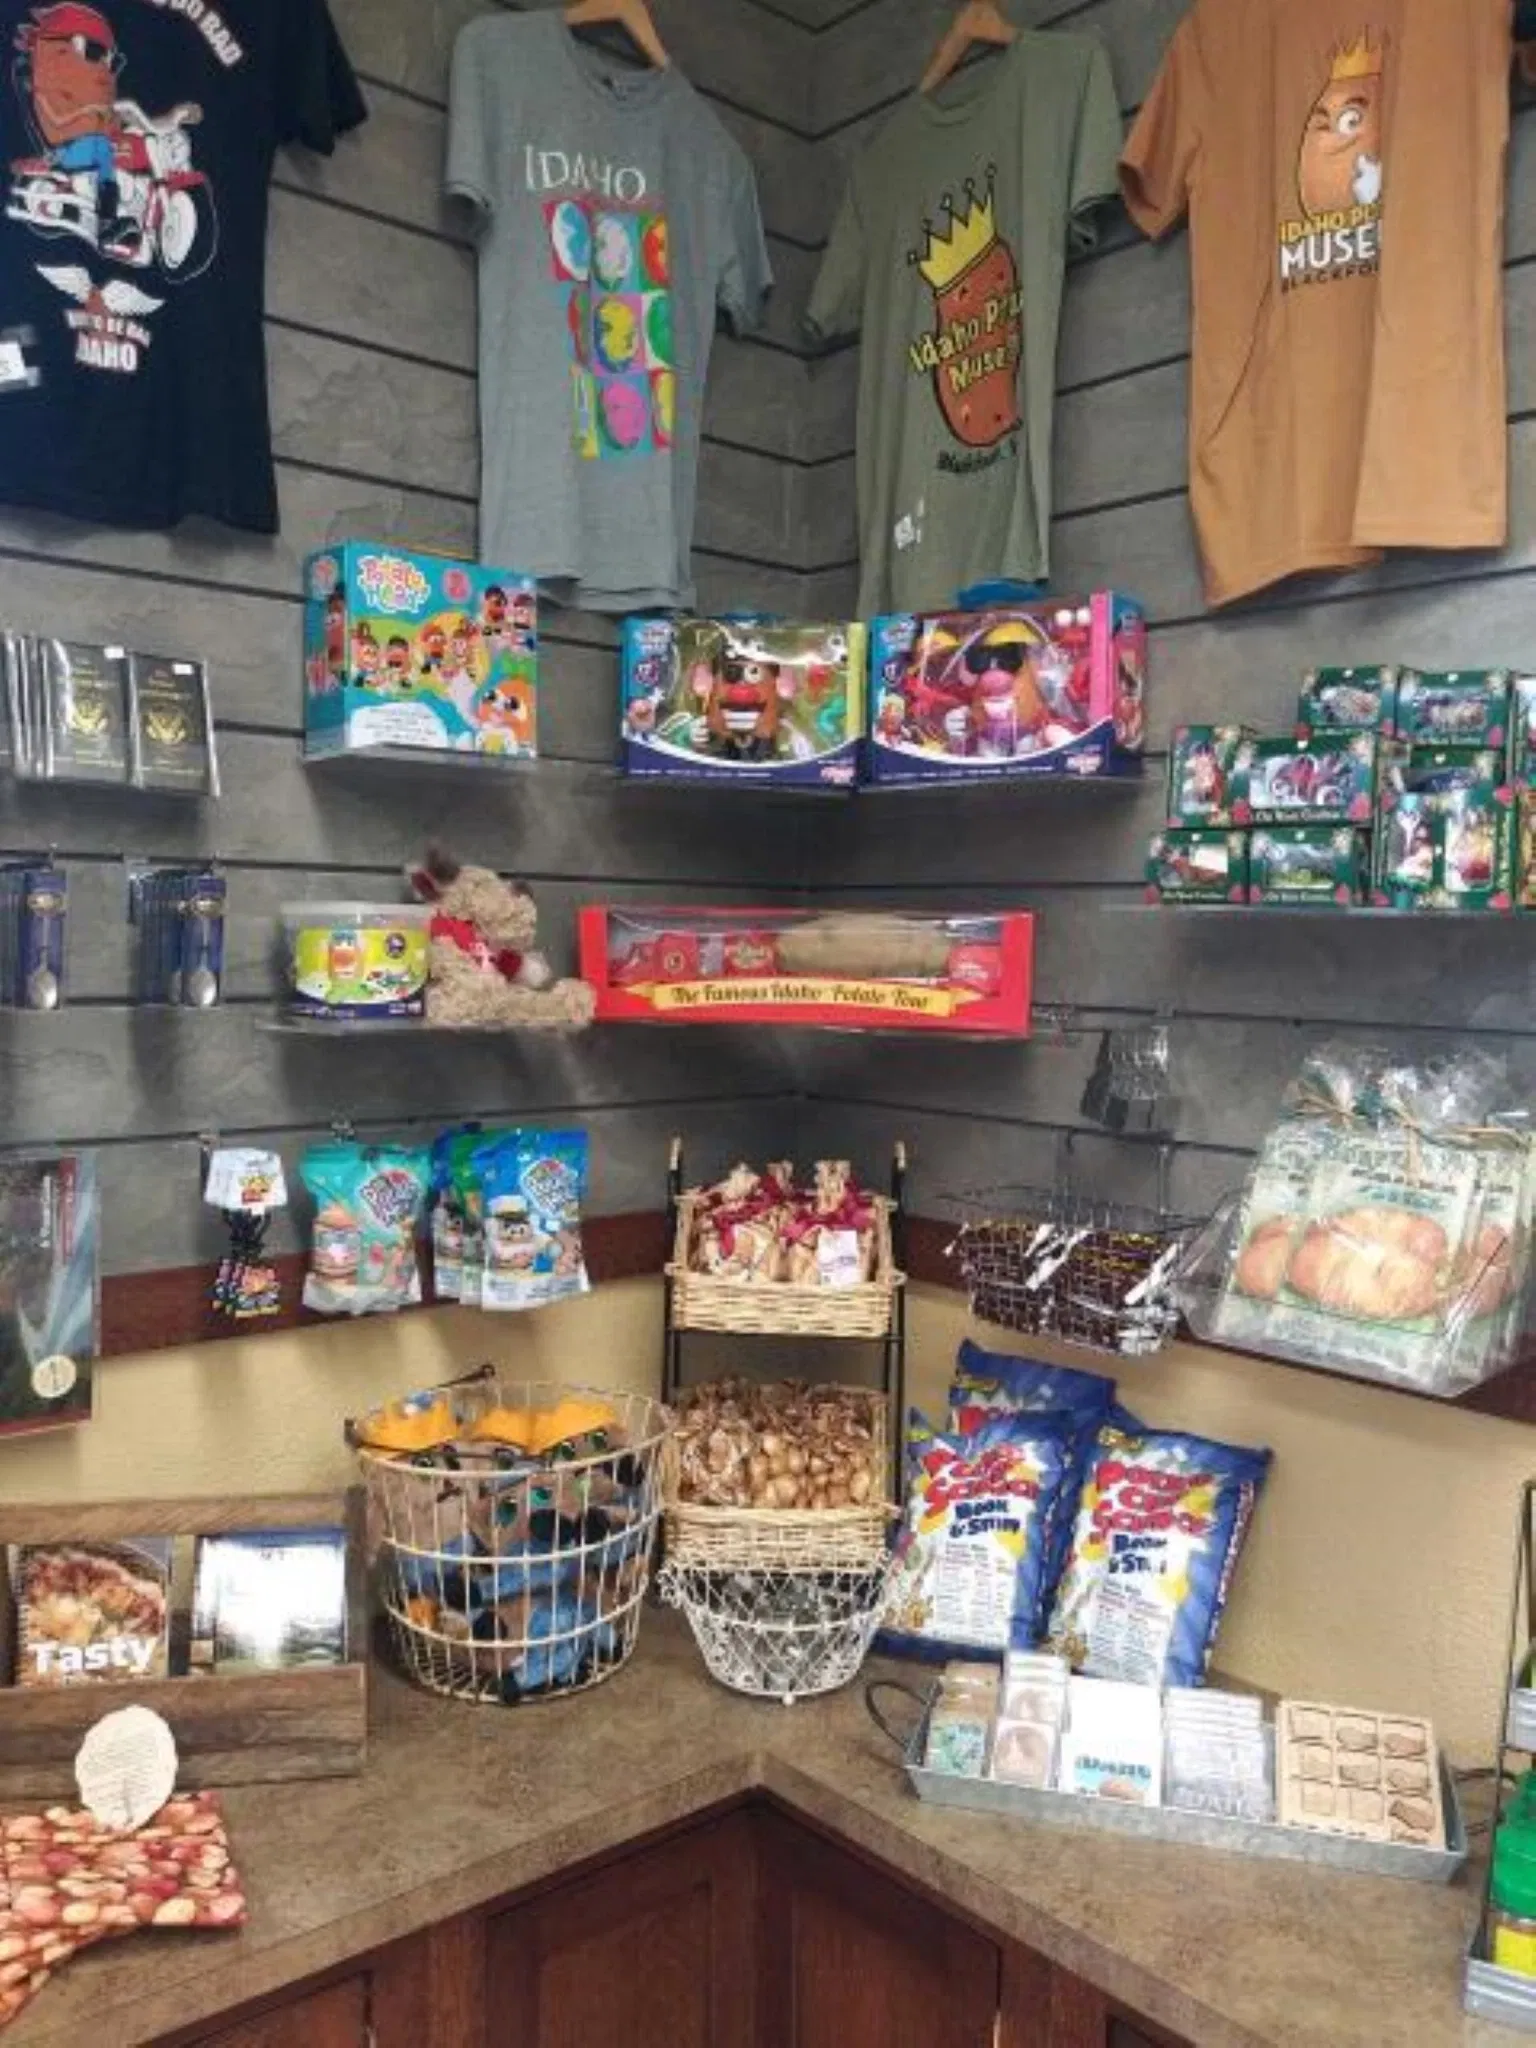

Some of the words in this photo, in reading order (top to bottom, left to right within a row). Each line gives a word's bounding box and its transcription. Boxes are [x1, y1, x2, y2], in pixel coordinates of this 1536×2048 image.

[525, 144, 647, 202] IDAHO
[1279, 209, 1345, 244] IDAHO
[908, 317, 979, 372] Idaho
[702, 984, 768, 1002] Famous
[769, 980, 823, 1002] Idaho
[830, 984, 886, 1004] Potato
[27, 1634, 159, 1676] Tasty
